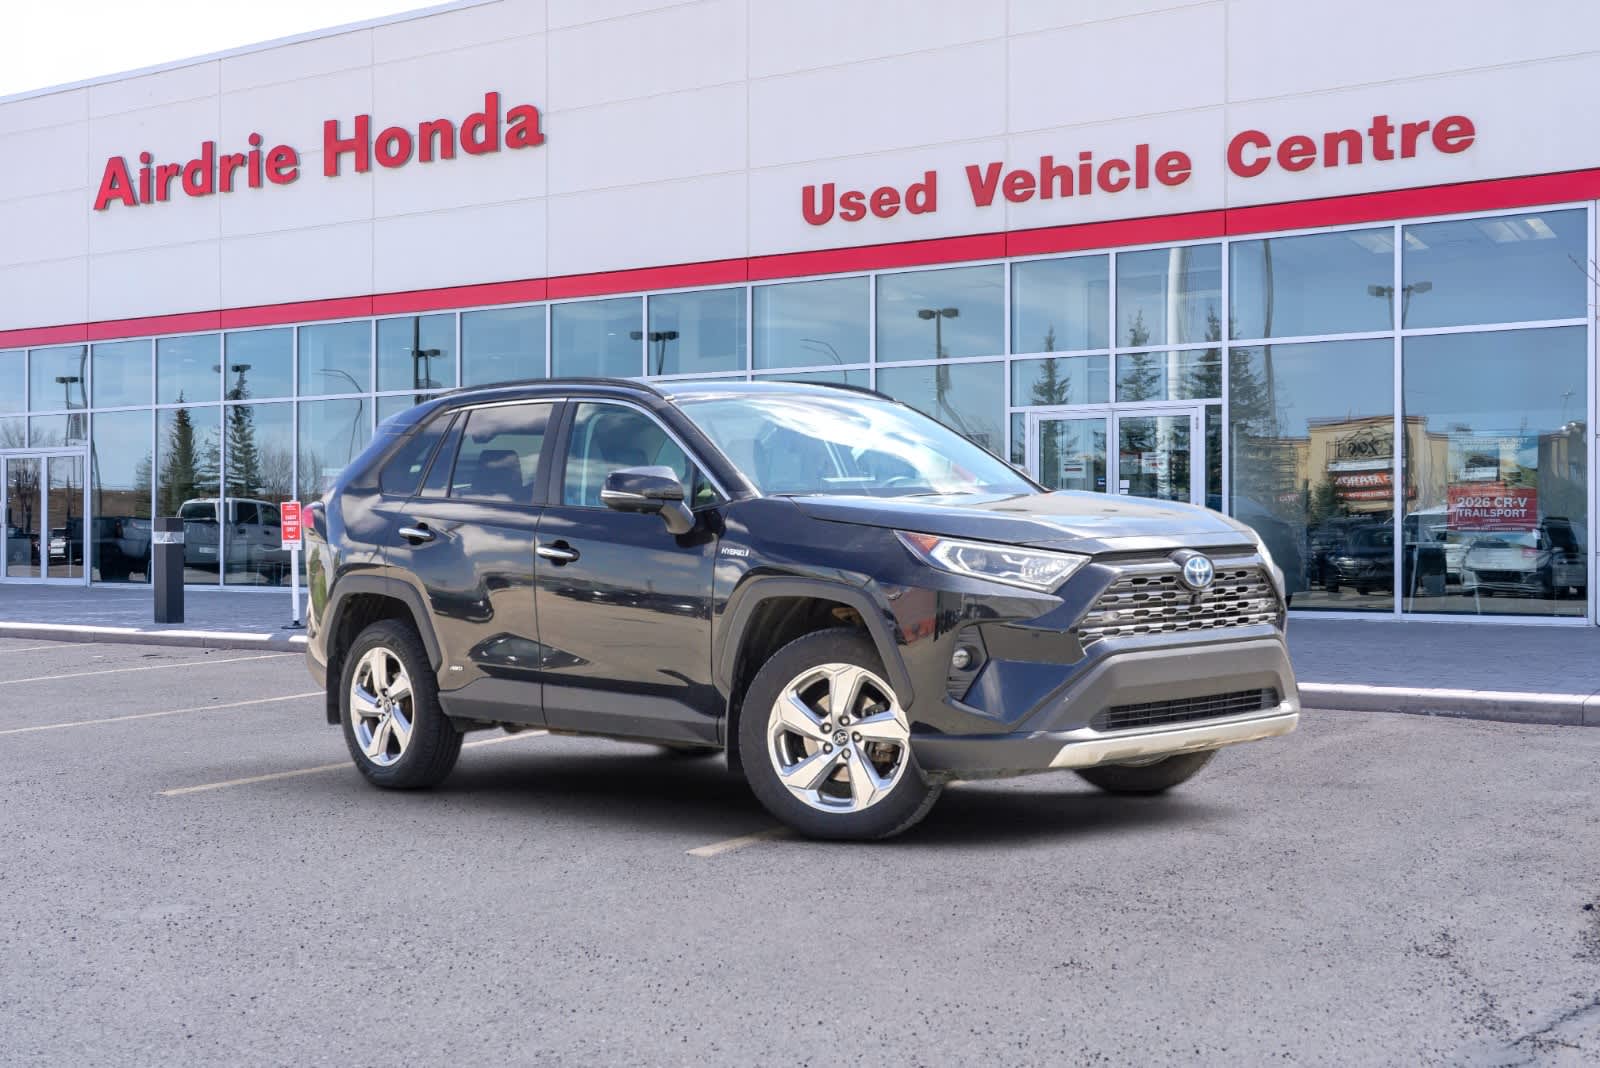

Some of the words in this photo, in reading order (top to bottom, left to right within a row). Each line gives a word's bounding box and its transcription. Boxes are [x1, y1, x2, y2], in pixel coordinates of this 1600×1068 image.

[94, 133, 298, 211] Airdrie
[323, 92, 546, 177] Honda
[803, 171, 937, 226] Used
[966, 144, 1192, 208] Vehicle
[1227, 115, 1476, 178] Centre
[1456, 497, 1490, 508] 2026
[1494, 497, 1528, 508] CR-V
[1457, 508, 1527, 518] TRAILSPORT
[720, 547, 745, 557] HYBRID
